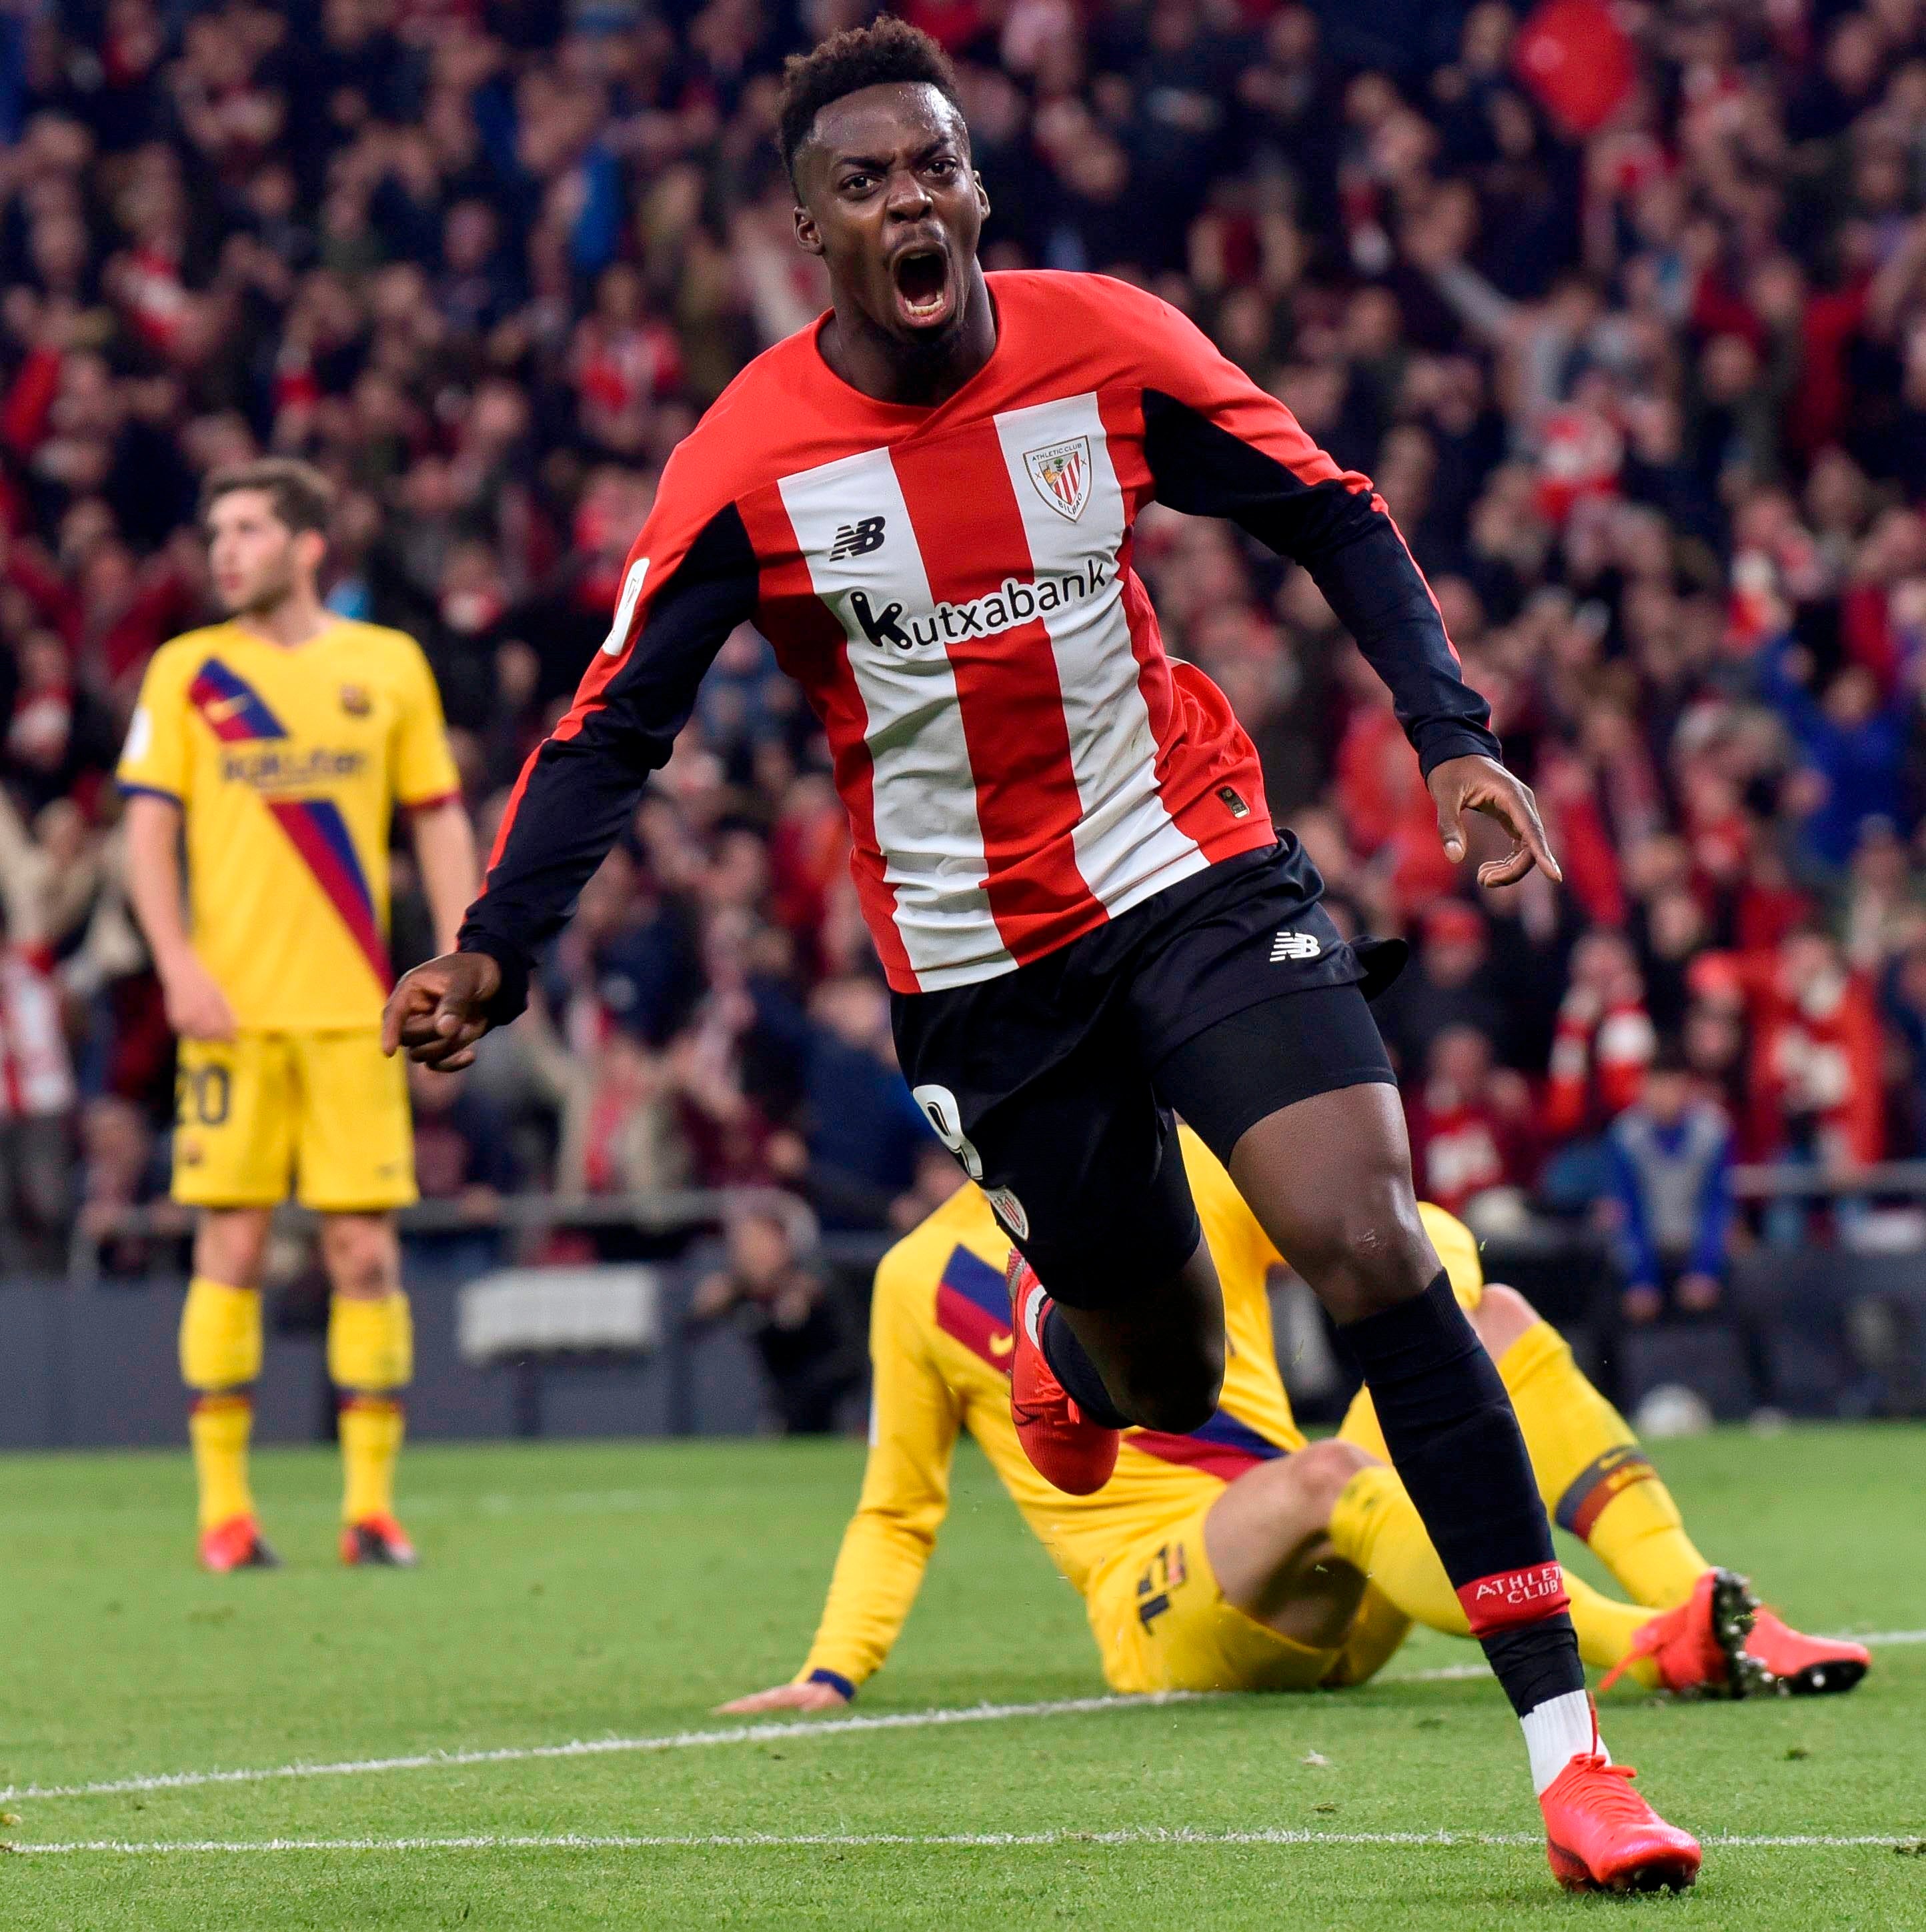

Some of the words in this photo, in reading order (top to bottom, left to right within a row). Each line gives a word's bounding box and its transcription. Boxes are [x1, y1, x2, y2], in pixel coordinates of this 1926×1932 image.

[1032, 448, 1064, 461] ATHLETIC
[1064, 443, 1082, 453] CLUB
[1057, 492, 1082, 515] BILBAO
[850, 559, 1106, 650] Kutxabank
[912, 1084, 984, 1180] 9
[1507, 1579, 1559, 1604] CLUB
